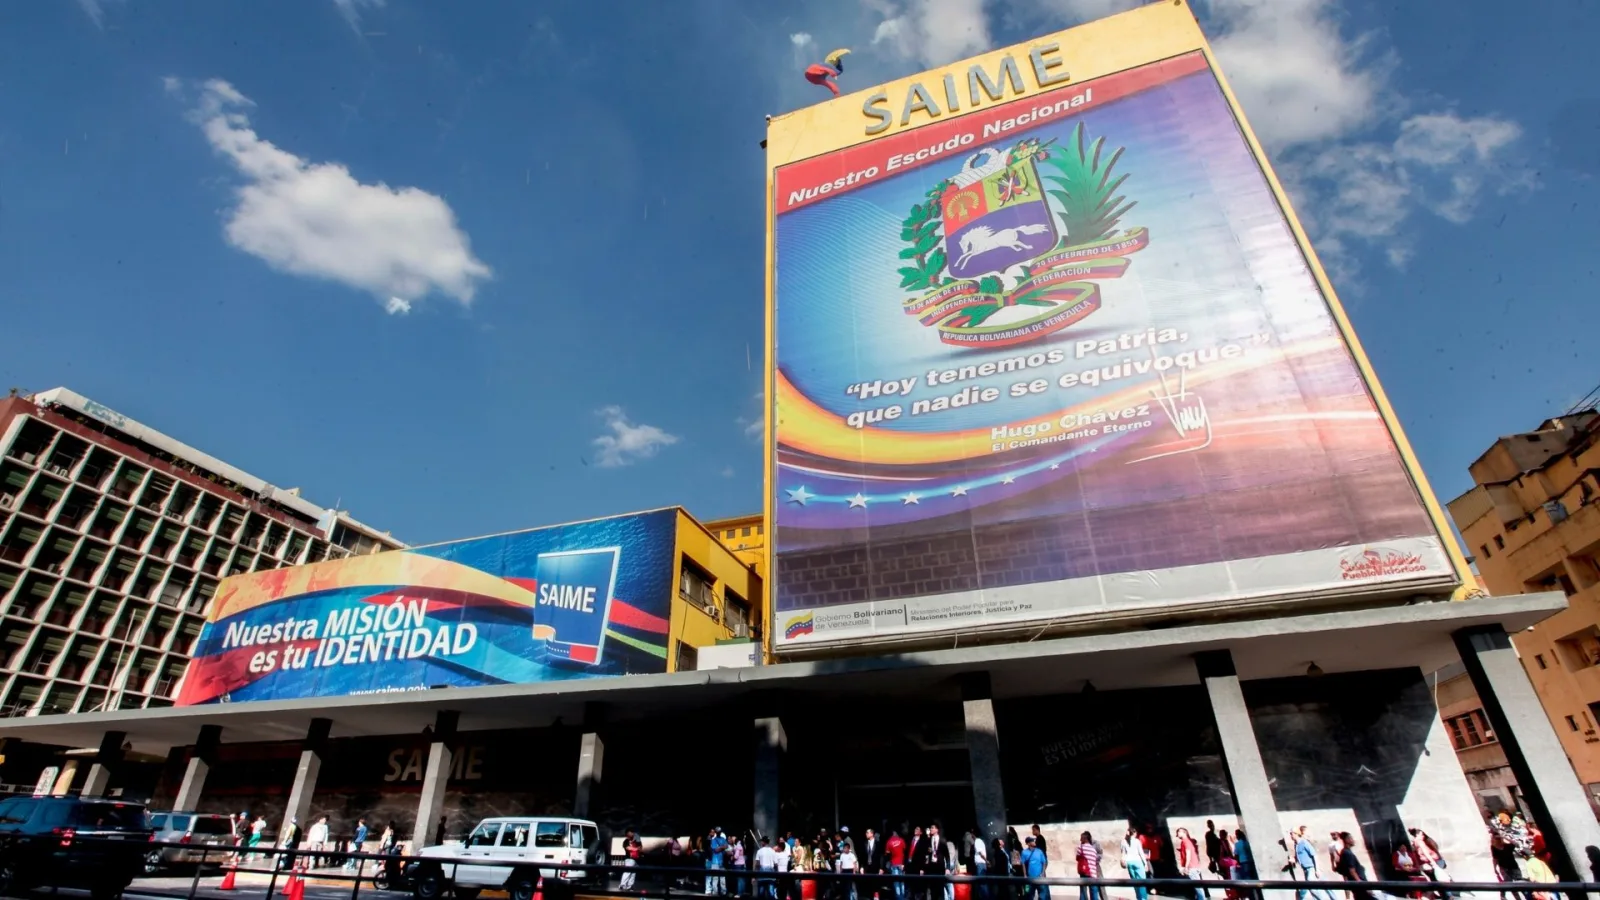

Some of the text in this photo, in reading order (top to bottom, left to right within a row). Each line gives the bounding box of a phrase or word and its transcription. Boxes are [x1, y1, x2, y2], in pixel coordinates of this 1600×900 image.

[862, 42, 1070, 136] SAIME
[788, 88, 1092, 206] Nuestro Escudo Nacional
[1060, 248, 1099, 261] FEBRERO
[1115, 238, 1139, 250] 1859
[931, 295, 985, 318] INDEPENDENCIA
[979, 327, 1031, 342] BOLIVARIANA
[1032, 323, 1044, 331] DE
[1044, 300, 1092, 327] VENEZUELA
[926, 348, 1064, 386] tenemos
[1075, 327, 1189, 359] Patria,
[847, 405, 902, 429] que
[911, 386, 1000, 415] nadie
[1010, 377, 1049, 397] se
[991, 404, 1151, 440] Hugo Chávez
[992, 420, 1152, 451] El Comandante Eterno
[539, 583, 595, 614] SAIME
[815, 608, 903, 623] Gobierno Bolivariano
[911, 612, 948, 621] Relaciones
[949, 608, 984, 618] Interiores,
[985, 606, 1012, 614] Justicia
[952, 603, 972, 611] Poder
[973, 601, 998, 609] Popular
[222, 595, 429, 648] Nuestra MISIÓN
[827, 618, 870, 629] Venezuela
[250, 622, 478, 673] es tu IDENTIDAD
[384, 745, 484, 782] SAME
